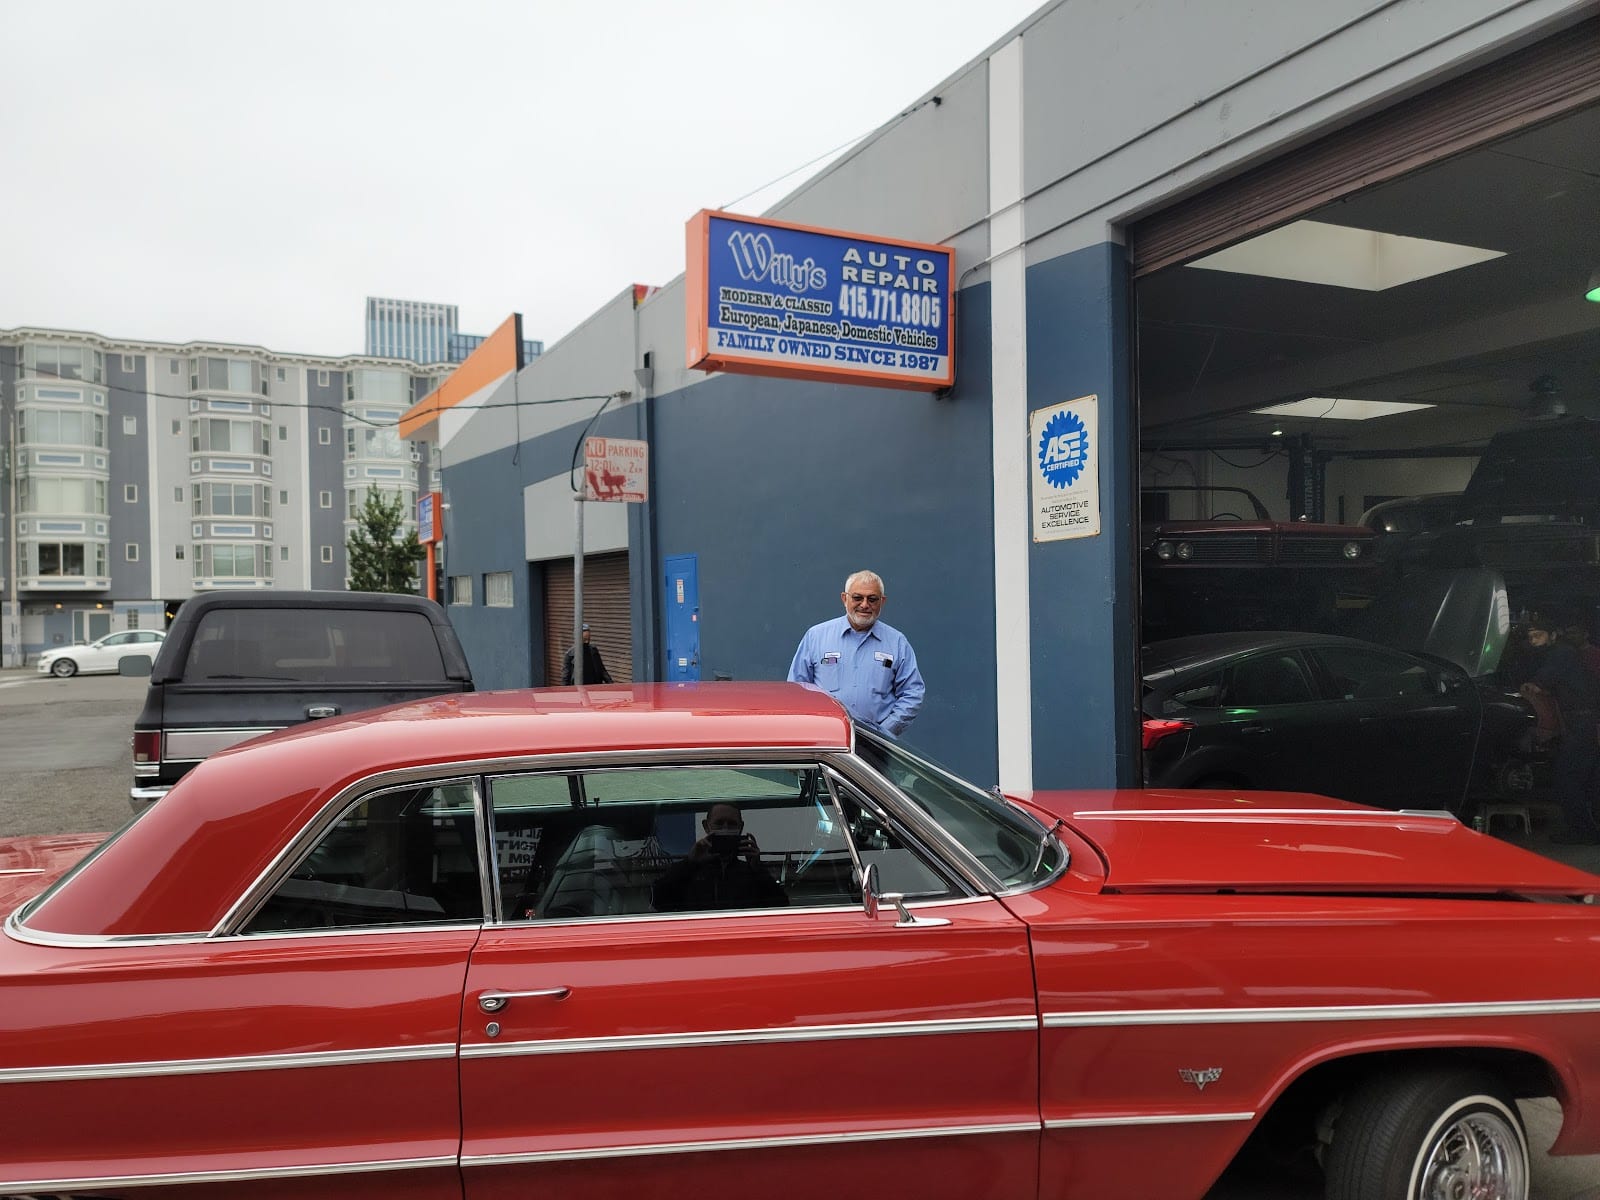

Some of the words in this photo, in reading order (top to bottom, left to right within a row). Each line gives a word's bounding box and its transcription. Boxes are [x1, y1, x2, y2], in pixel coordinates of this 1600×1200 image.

[727, 231, 827, 293] Willy's
[842, 248, 935, 275] AUTO
[842, 266, 938, 294] REPAIR
[720, 287, 773, 307] MODERN
[774, 296, 783, 309] &
[785, 297, 832, 315] CLASSIC
[839, 284, 941, 328] 415.771.8805
[720, 305, 781, 332] European,
[784, 314, 840, 339] Japanese,
[841, 322, 892, 343] Domestic
[893, 328, 938, 349] Vehicles
[717, 331, 775, 353] FAMILY
[778, 338, 832, 359] OWNED
[834, 345, 897, 367] SINCE
[899, 353, 940, 372] 1987
[588, 439, 605, 457] NO
[608, 445, 645, 458] PARKING
[1044, 431, 1081, 465] ASE
[1047, 459, 1080, 472] CERTIFIED
[1040, 500, 1089, 514] AUTOMOTIVE
[1049, 509, 1081, 520] SERVICE
[1041, 516, 1089, 529] EXCELLENCE
